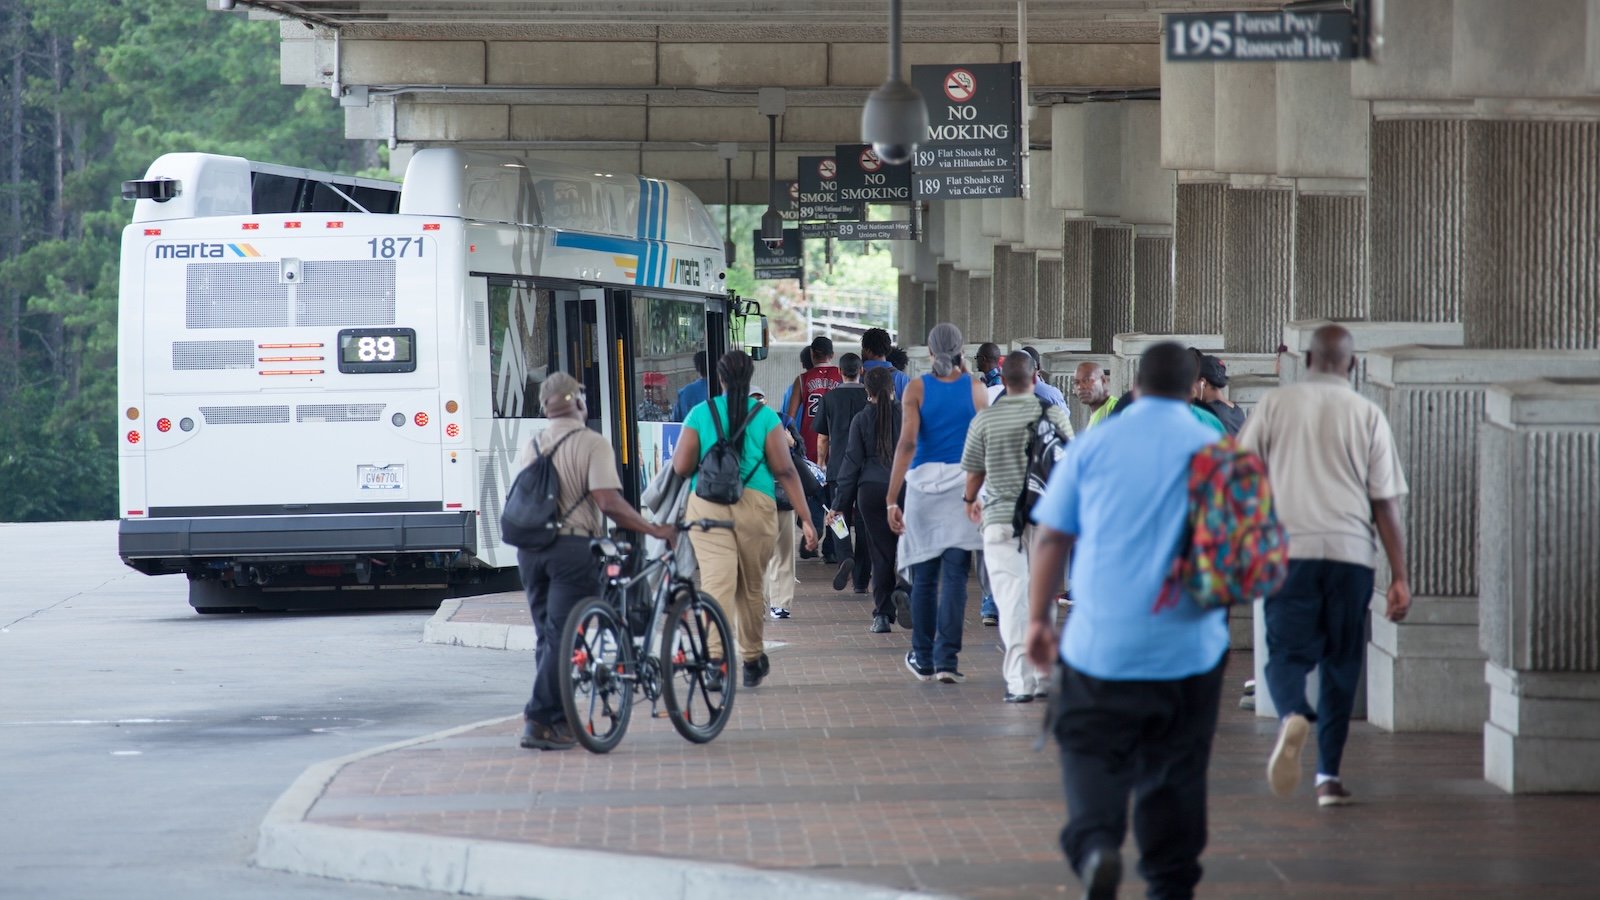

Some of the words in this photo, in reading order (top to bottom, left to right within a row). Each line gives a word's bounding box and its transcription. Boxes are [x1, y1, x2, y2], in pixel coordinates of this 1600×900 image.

[1234, 13, 1281, 33] Forest
[1171, 21, 1233, 55] 195
[1234, 37, 1304, 57] Roosevelt
[1307, 36, 1341, 61] Hwy
[948, 105, 977, 120] NO
[927, 124, 1009, 140] MOKING
[914, 151, 935, 167] 189
[938, 149, 953, 157] Flat
[955, 148, 982, 157] Shoals
[984, 148, 996, 156] Rd
[939, 160, 951, 168] via
[953, 159, 994, 167] Hillandale
[997, 158, 1007, 166] Dr
[864, 174, 886, 185] NO
[919, 178, 940, 194] 189
[946, 176, 962, 185] Flat
[964, 175, 990, 184] Shoals
[992, 175, 1004, 183] Rd
[841, 187, 909, 199] SMOKING
[949, 187, 961, 195] via
[963, 186, 986, 194] Cadiz
[988, 185, 1002, 194] Cir
[800, 206, 814, 218] 89
[840, 224, 854, 235] 89
[155, 242, 224, 258] marta
[367, 237, 424, 258] 1871
[757, 256, 798, 265] SMOKING
[680, 258, 700, 286] marta
[357, 336, 396, 361] 89
